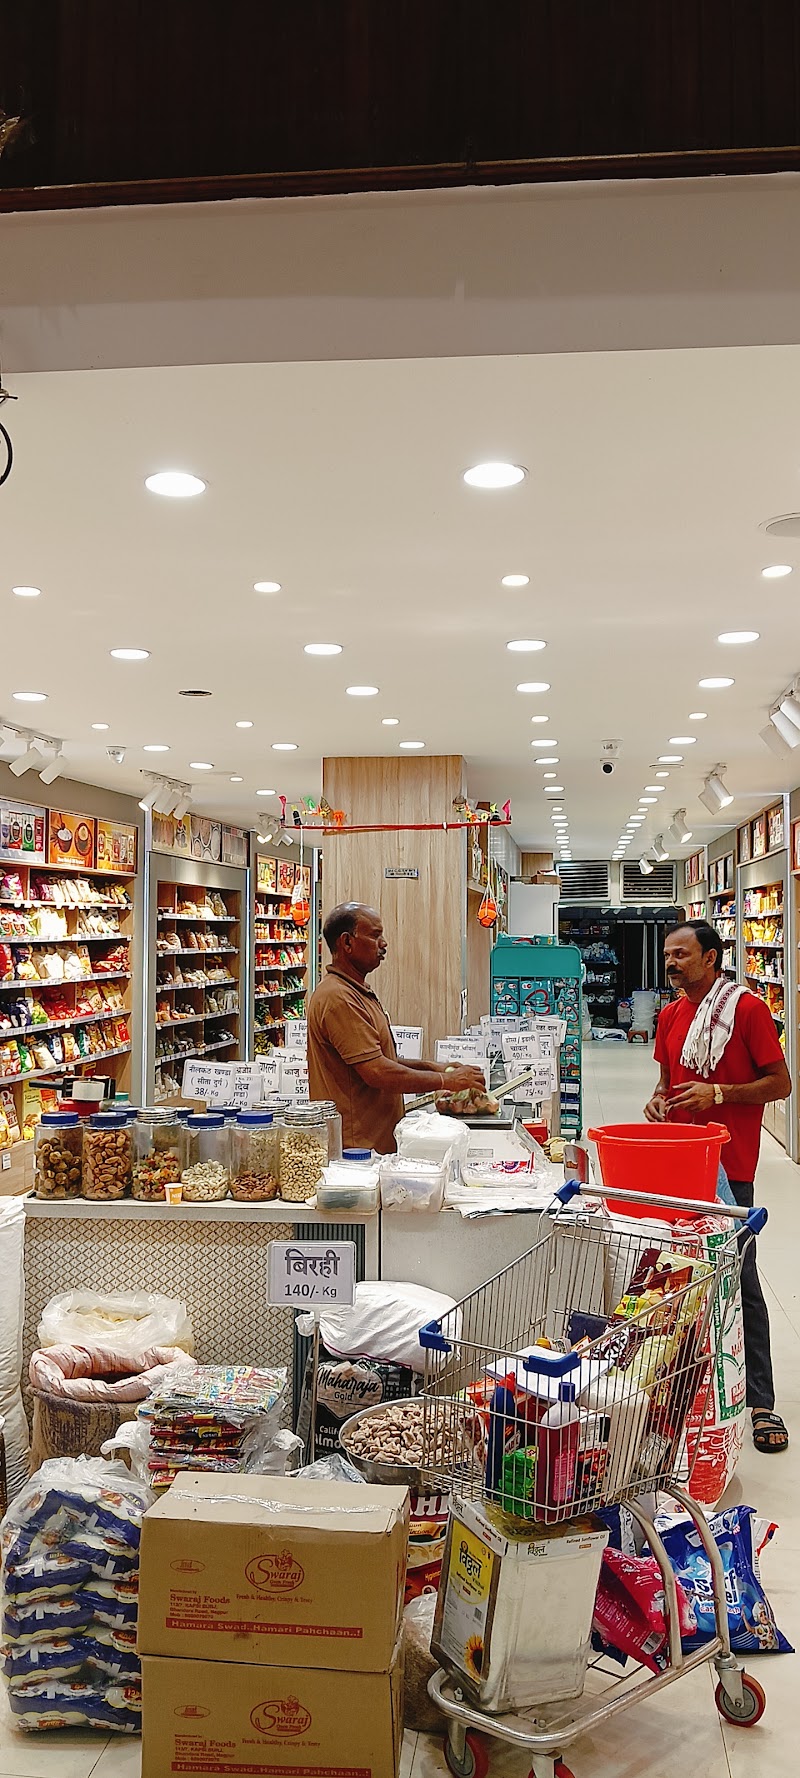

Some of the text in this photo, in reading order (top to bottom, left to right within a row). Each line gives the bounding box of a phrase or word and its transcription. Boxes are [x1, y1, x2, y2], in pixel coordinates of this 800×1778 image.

[194, 1088, 209, 1096] 38/-
[284, 1248, 340, 1278] बिरही
[284, 1284, 337, 1298] 140/- Kg
[318, 1367, 380, 1398] Maharaja
[334, 1391, 352, 1401] Gold
[250, 1558, 302, 1584] Swaraj
[170, 1594, 230, 1604] Swaraj Foods
[172, 1621, 214, 1629] Hamara
[254, 1704, 308, 1730] Swaraj
[175, 1739, 236, 1748] Swaraj Foods
[176, 1764, 220, 1772] Hamara
